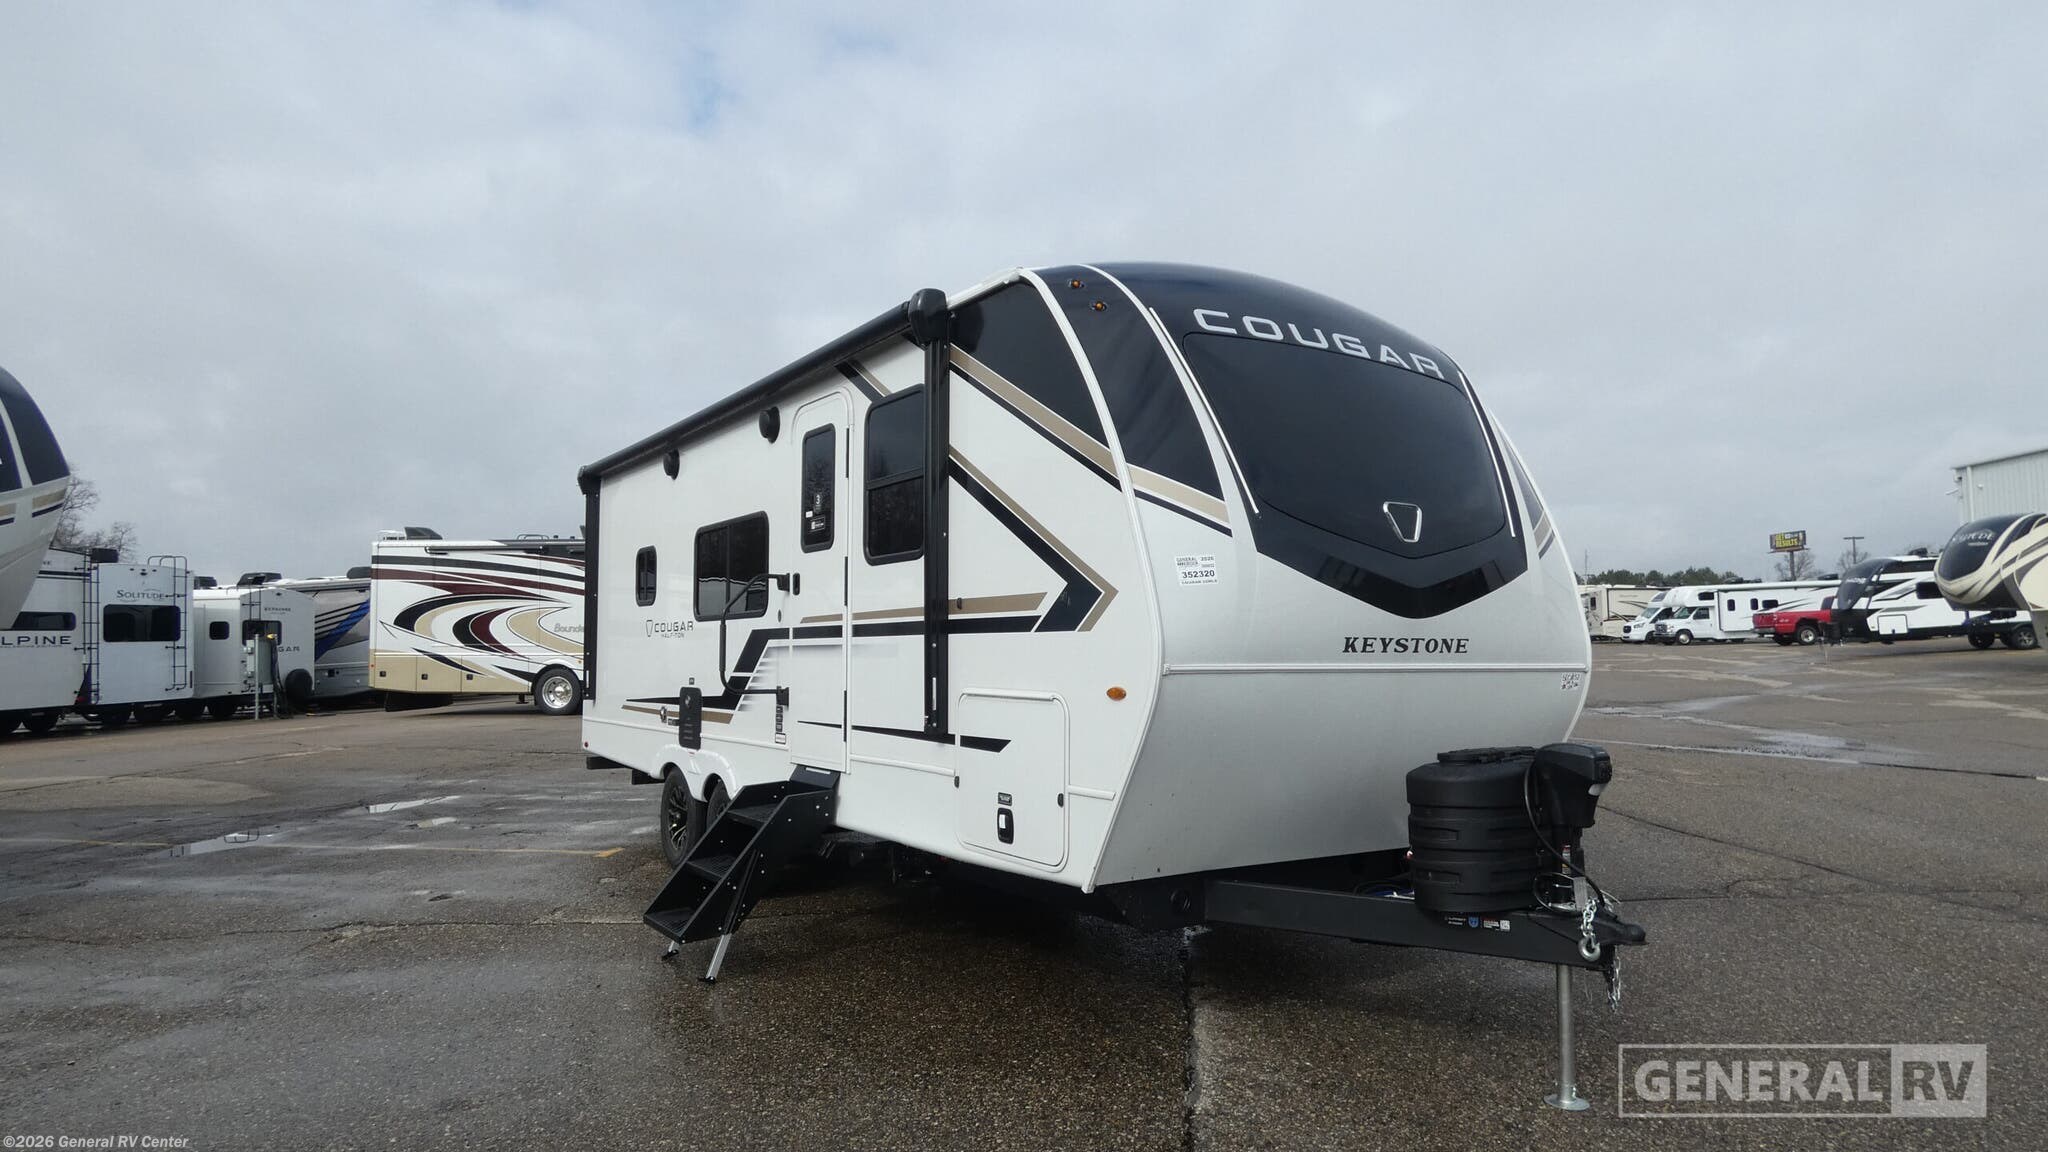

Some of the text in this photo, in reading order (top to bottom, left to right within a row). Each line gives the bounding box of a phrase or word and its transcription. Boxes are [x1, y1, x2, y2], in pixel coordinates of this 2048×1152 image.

[1193, 308, 1445, 379] COUGAR
[1182, 570, 1215, 578] 352320
[116, 589, 165, 600] SOLITUDE
[553, 622, 585, 633] Bounde
[654, 621, 694, 633] COUGAR
[1, 635, 72, 646] LPINE
[1342, 636, 1470, 654] KEYSTONE
